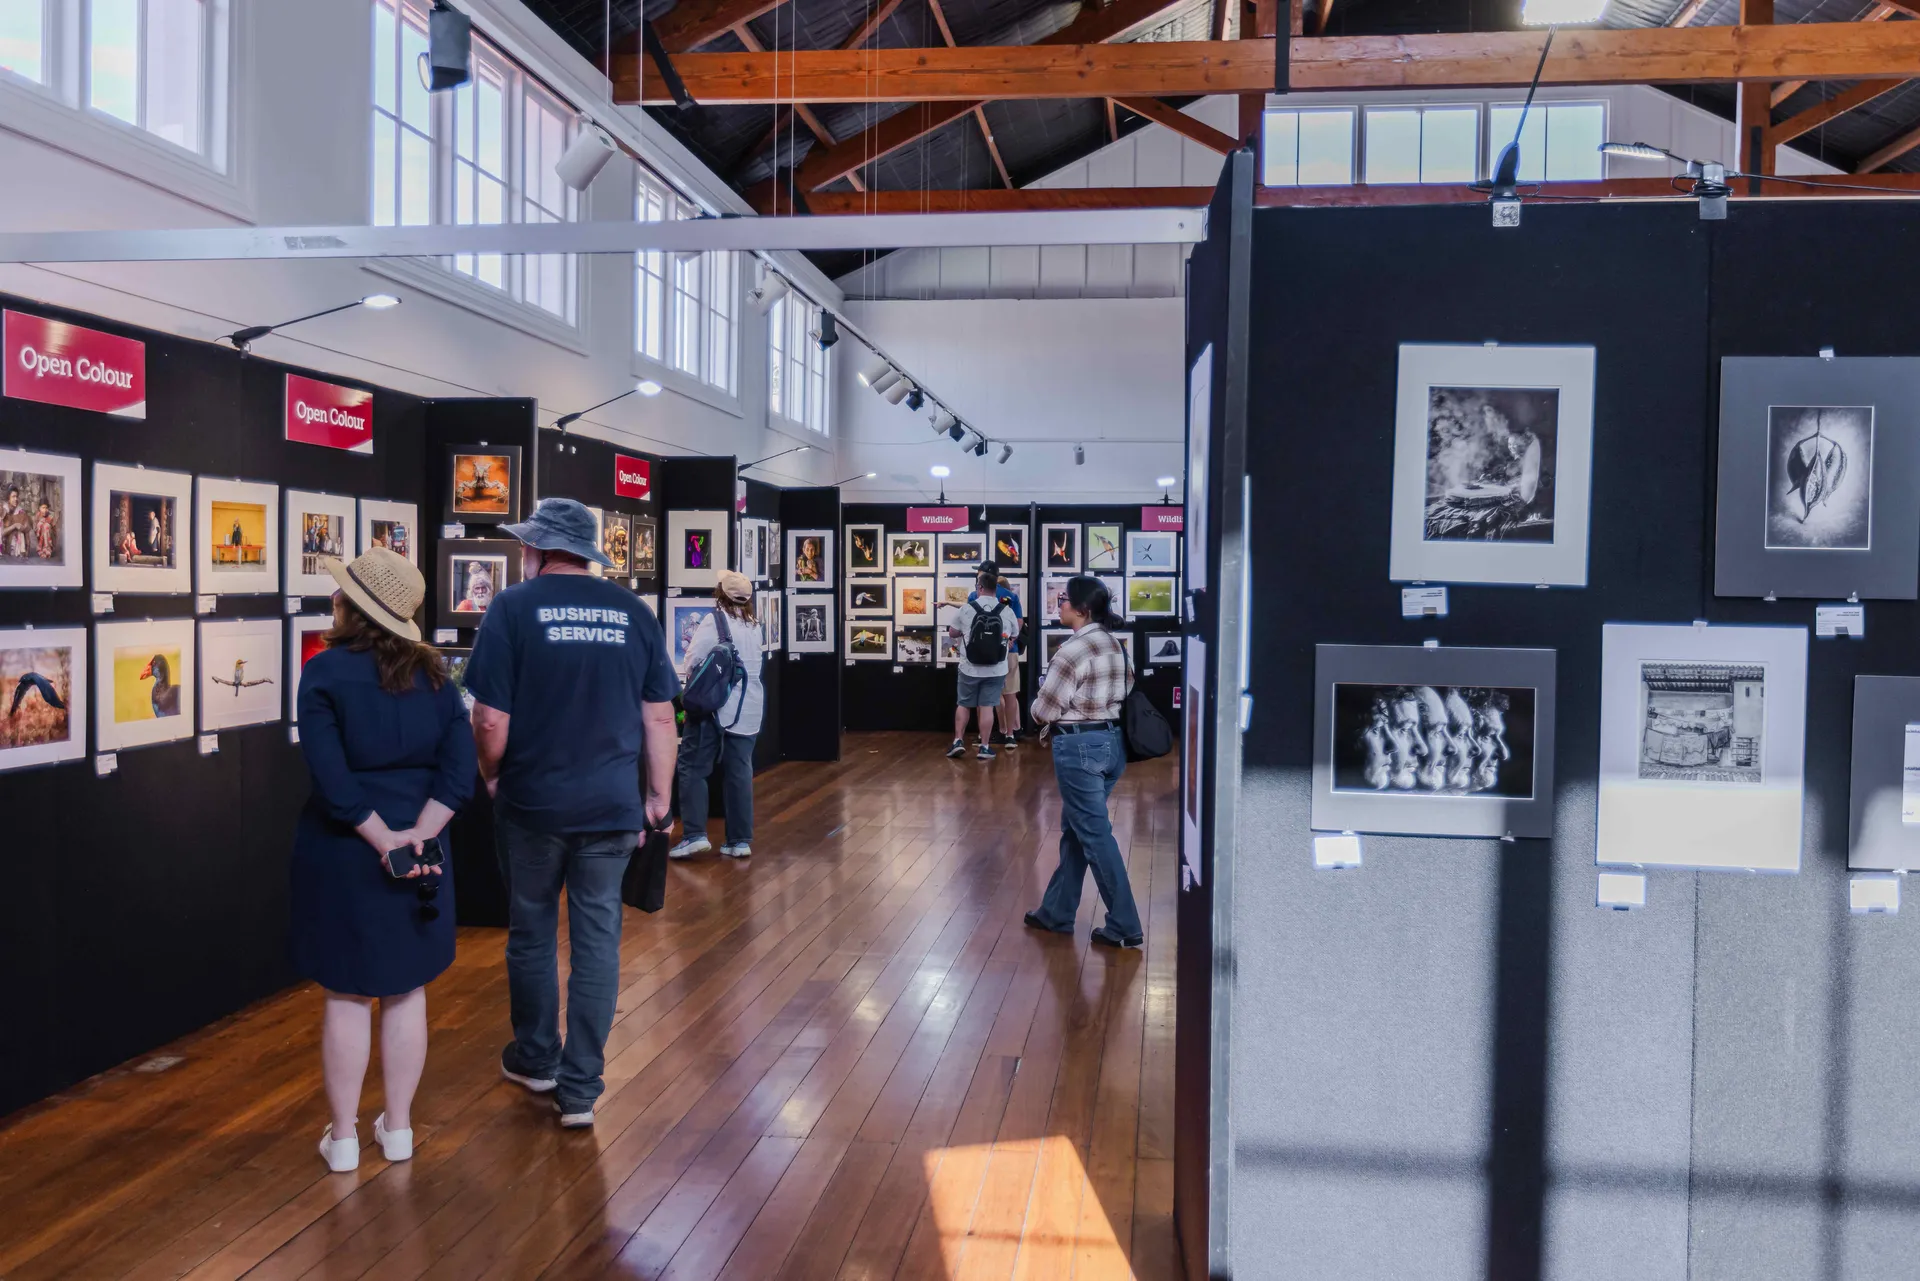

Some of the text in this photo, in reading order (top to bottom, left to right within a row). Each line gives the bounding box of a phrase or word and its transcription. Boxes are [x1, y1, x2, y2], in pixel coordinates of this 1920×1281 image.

[21, 347, 133, 388] Open Colour
[297, 401, 365, 430] Open Colour
[620, 470, 647, 486] Open Colour
[1158, 515, 1183, 523] Wildli
[540, 608, 628, 625] BUSHFIRE
[548, 627, 625, 643] SERVICE
